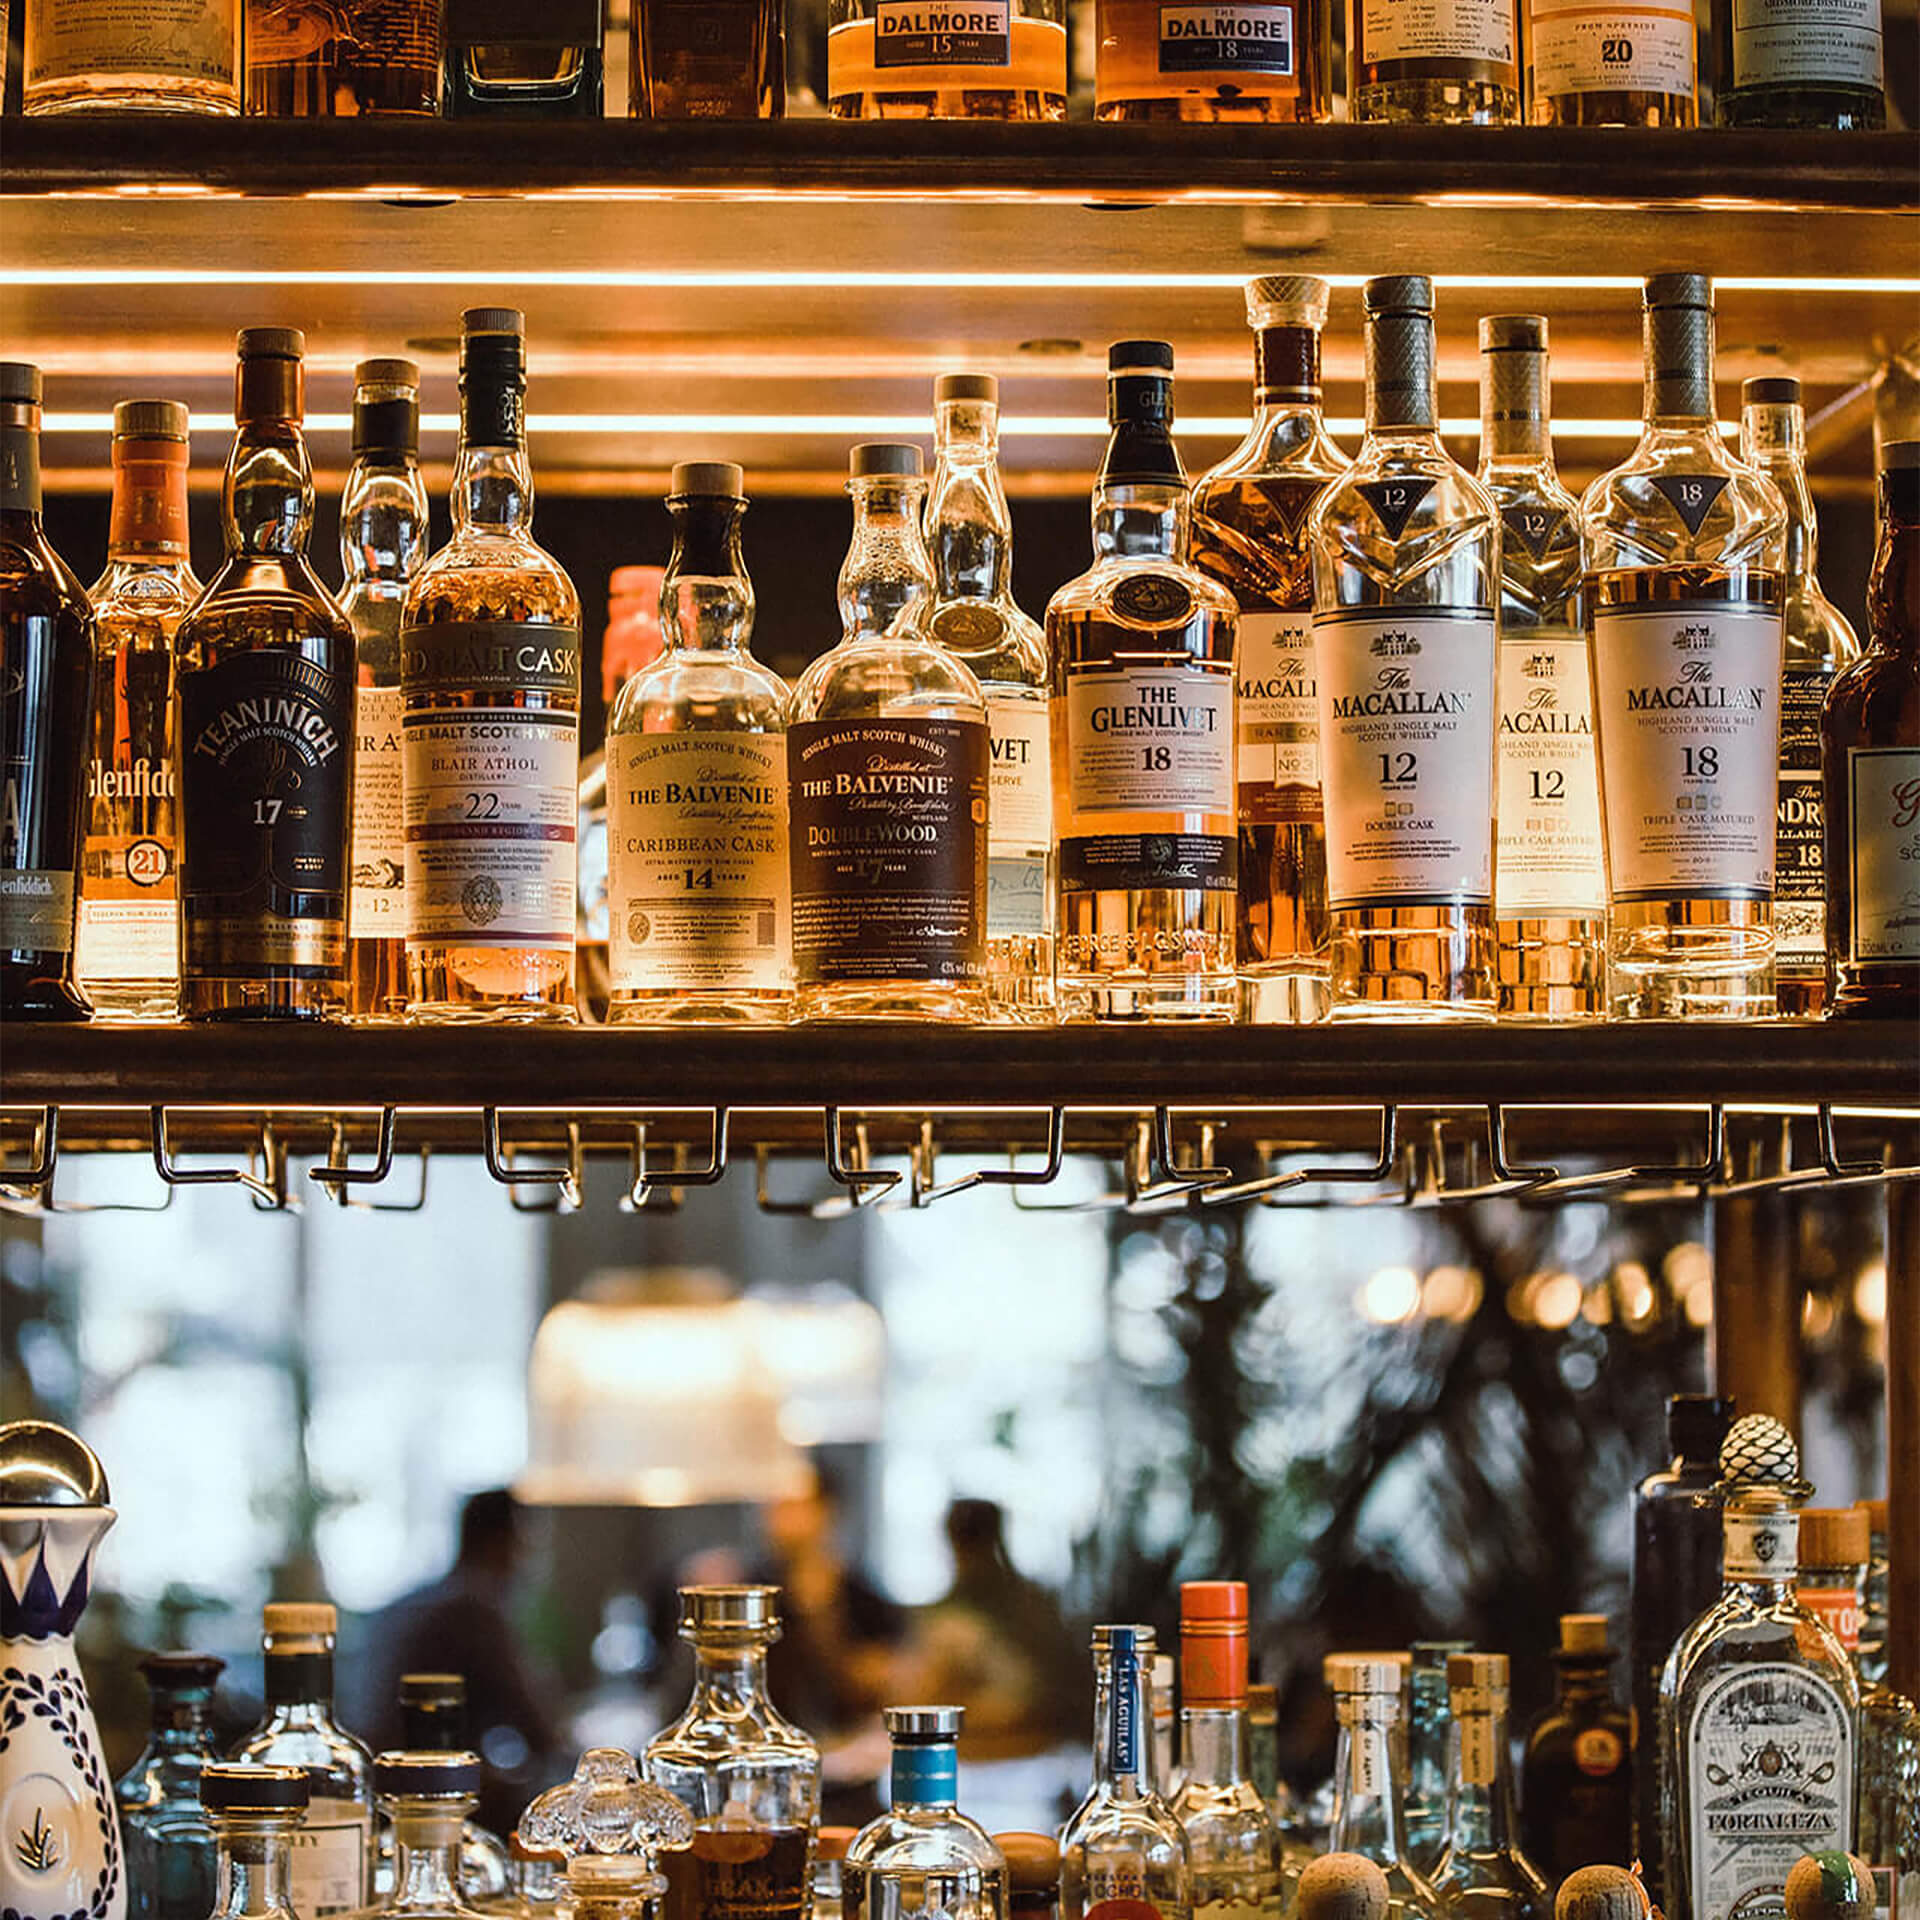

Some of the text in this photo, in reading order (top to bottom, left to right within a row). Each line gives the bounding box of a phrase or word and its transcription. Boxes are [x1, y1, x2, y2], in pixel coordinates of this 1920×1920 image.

[1214, 9, 1234, 17] THE
[884, 14, 1000, 33] DALMORE
[1168, 19, 1283, 38] DALMORE
[931, 36, 951, 53] 15
[1217, 41, 1238, 58] 18
[1601, 40, 1632, 63] 20
[1382, 487, 1407, 507] 12
[1680, 484, 1704, 502] 18
[1523, 514, 1546, 532] 12
[517, 646, 575, 676] CASK
[1275, 658, 1305, 678] The
[1374, 667, 1411, 692] The
[1677, 661, 1713, 685] The
[1137, 687, 1177, 704] THE
[1524, 687, 1559, 711] The
[1626, 686, 1764, 712] MACALLAN
[1333, 692, 1466, 720] MACALLAN
[1091, 705, 1217, 733] GLENLIVET
[1341, 719, 1458, 734] HIGHLAND SINGLE MALT
[1637, 716, 1692, 728] HIGHLAND
[1695, 715, 1731, 726] SINGLE
[193, 697, 339, 763] TEANINICH
[263, 727, 295, 743] SCOTCH
[430, 727, 467, 740] MALT
[470, 726, 533, 741] SCOTCH
[1357, 730, 1438, 743] SCOTCH WHISKY
[1657, 726, 1739, 737] SCOTCH WHISKY
[455, 744, 499, 753] DISTILLED
[801, 729, 948, 761] SINGLE MALT SCOTCH WHISKY
[432, 757, 539, 772] BLAIR ATHOL
[629, 741, 774, 770] SINGLE MALT SCOTCH WHISKY
[1141, 746, 1172, 771] 18
[1679, 746, 1720, 778] 18
[458, 773, 508, 782] DISTILLERY
[1377, 752, 1418, 785] 12
[629, 783, 775, 806] THE BALVENIE
[801, 773, 950, 799] THE BALVENIE
[1528, 769, 1566, 800] 12
[253, 799, 283, 825] 17
[465, 792, 502, 820] 22
[911, 814, 949, 822] SCOTLAND
[1364, 819, 1435, 833] DOUBLE CASK
[1643, 815, 1676, 827] TRIPLE
[1679, 814, 1710, 826] CASK
[627, 837, 776, 854] CARIBBEAN CASK
[133, 850, 161, 875] 21
[1797, 844, 1823, 868] 18
[684, 867, 713, 890] 14
[857, 857, 885, 884] 17
[884, 863, 907, 872] YEARS
[372, 900, 390, 914] 12
[1729, 1786, 1812, 1806] TEQUILA
[1707, 1812, 1837, 1832] FORTALEZA
